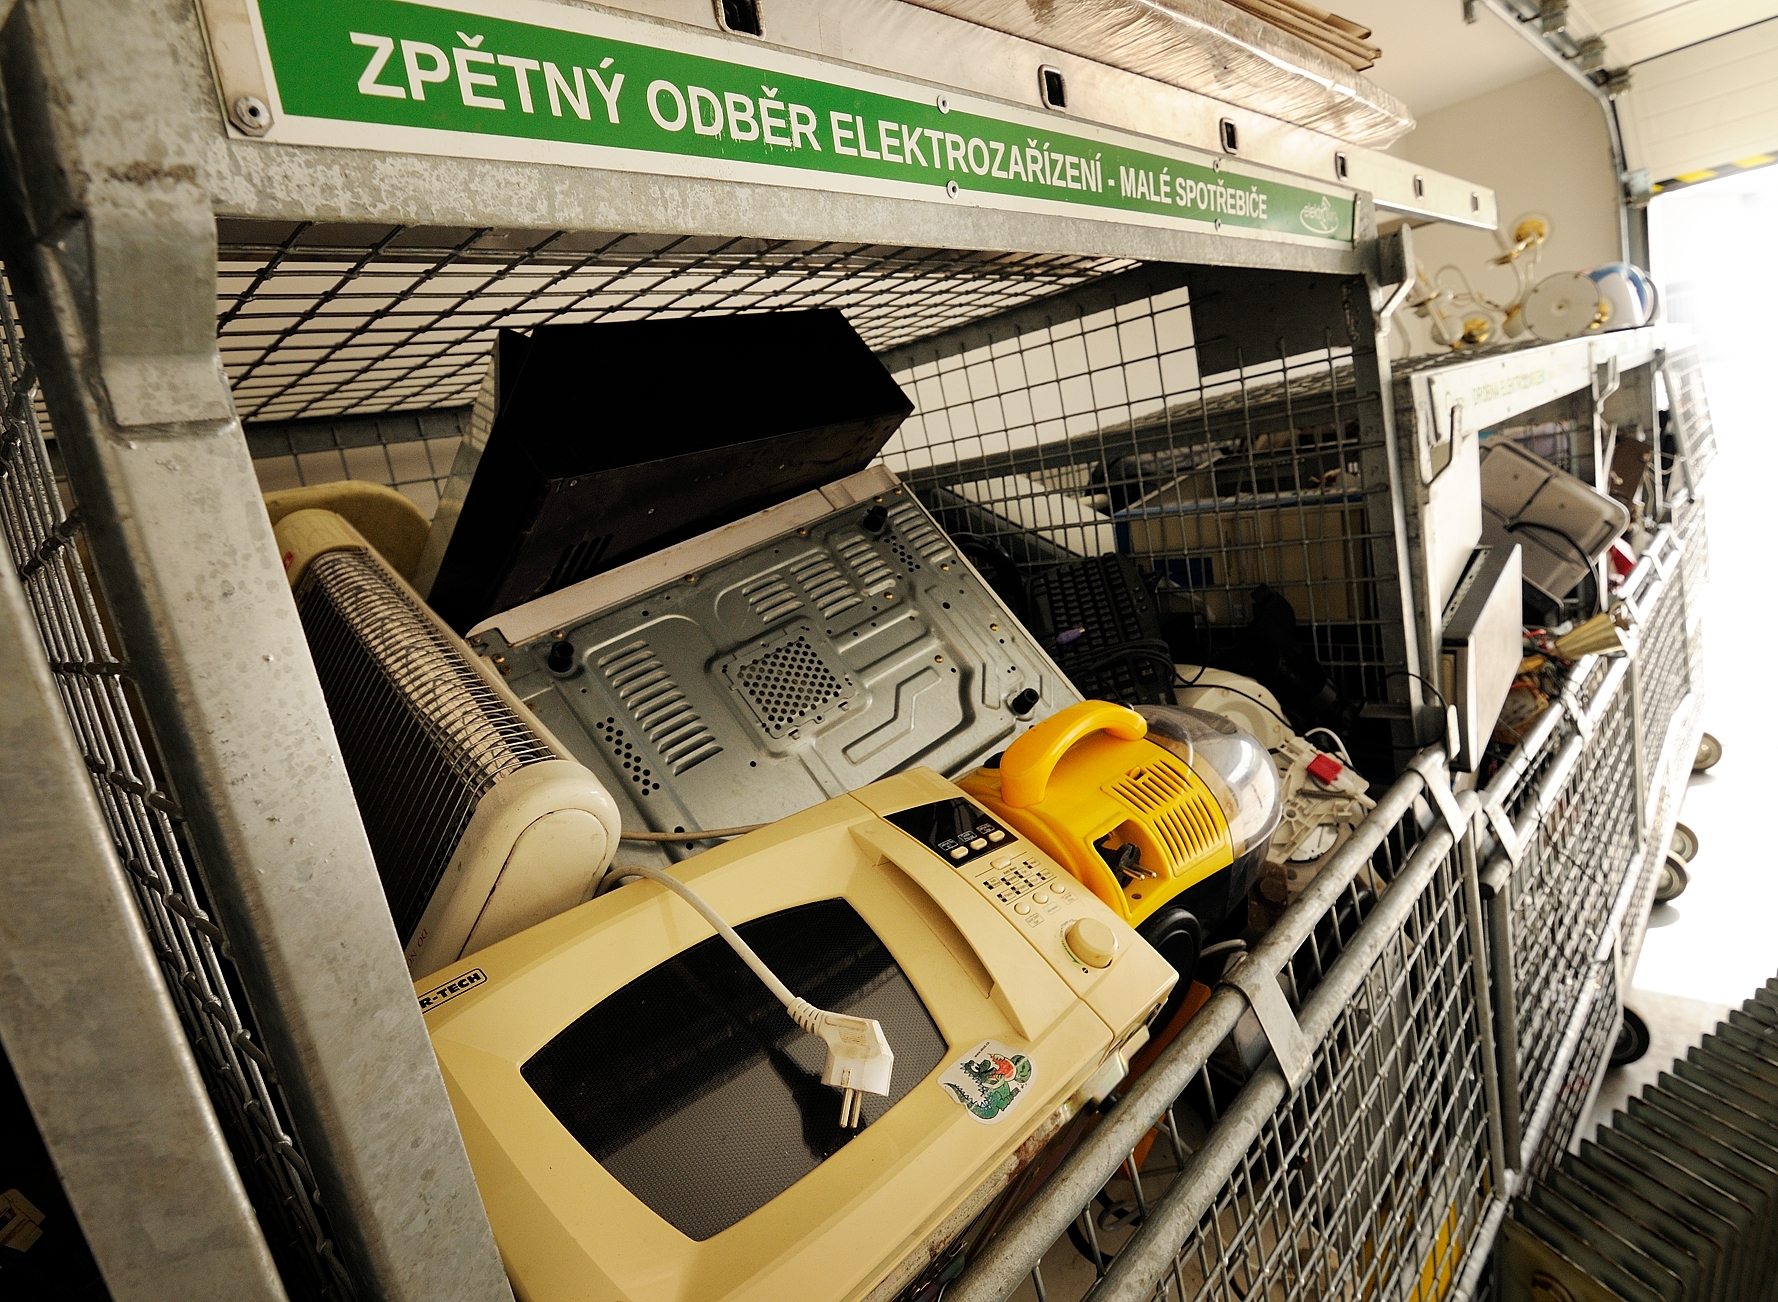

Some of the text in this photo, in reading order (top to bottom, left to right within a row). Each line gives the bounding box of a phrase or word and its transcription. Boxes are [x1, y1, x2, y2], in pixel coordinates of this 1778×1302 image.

[349, 31, 1268, 220] ZPĚTNÝ ODBĚR ELEKTROZAŘÍZENÍ - MALÉ SPOTŘEBIČE
